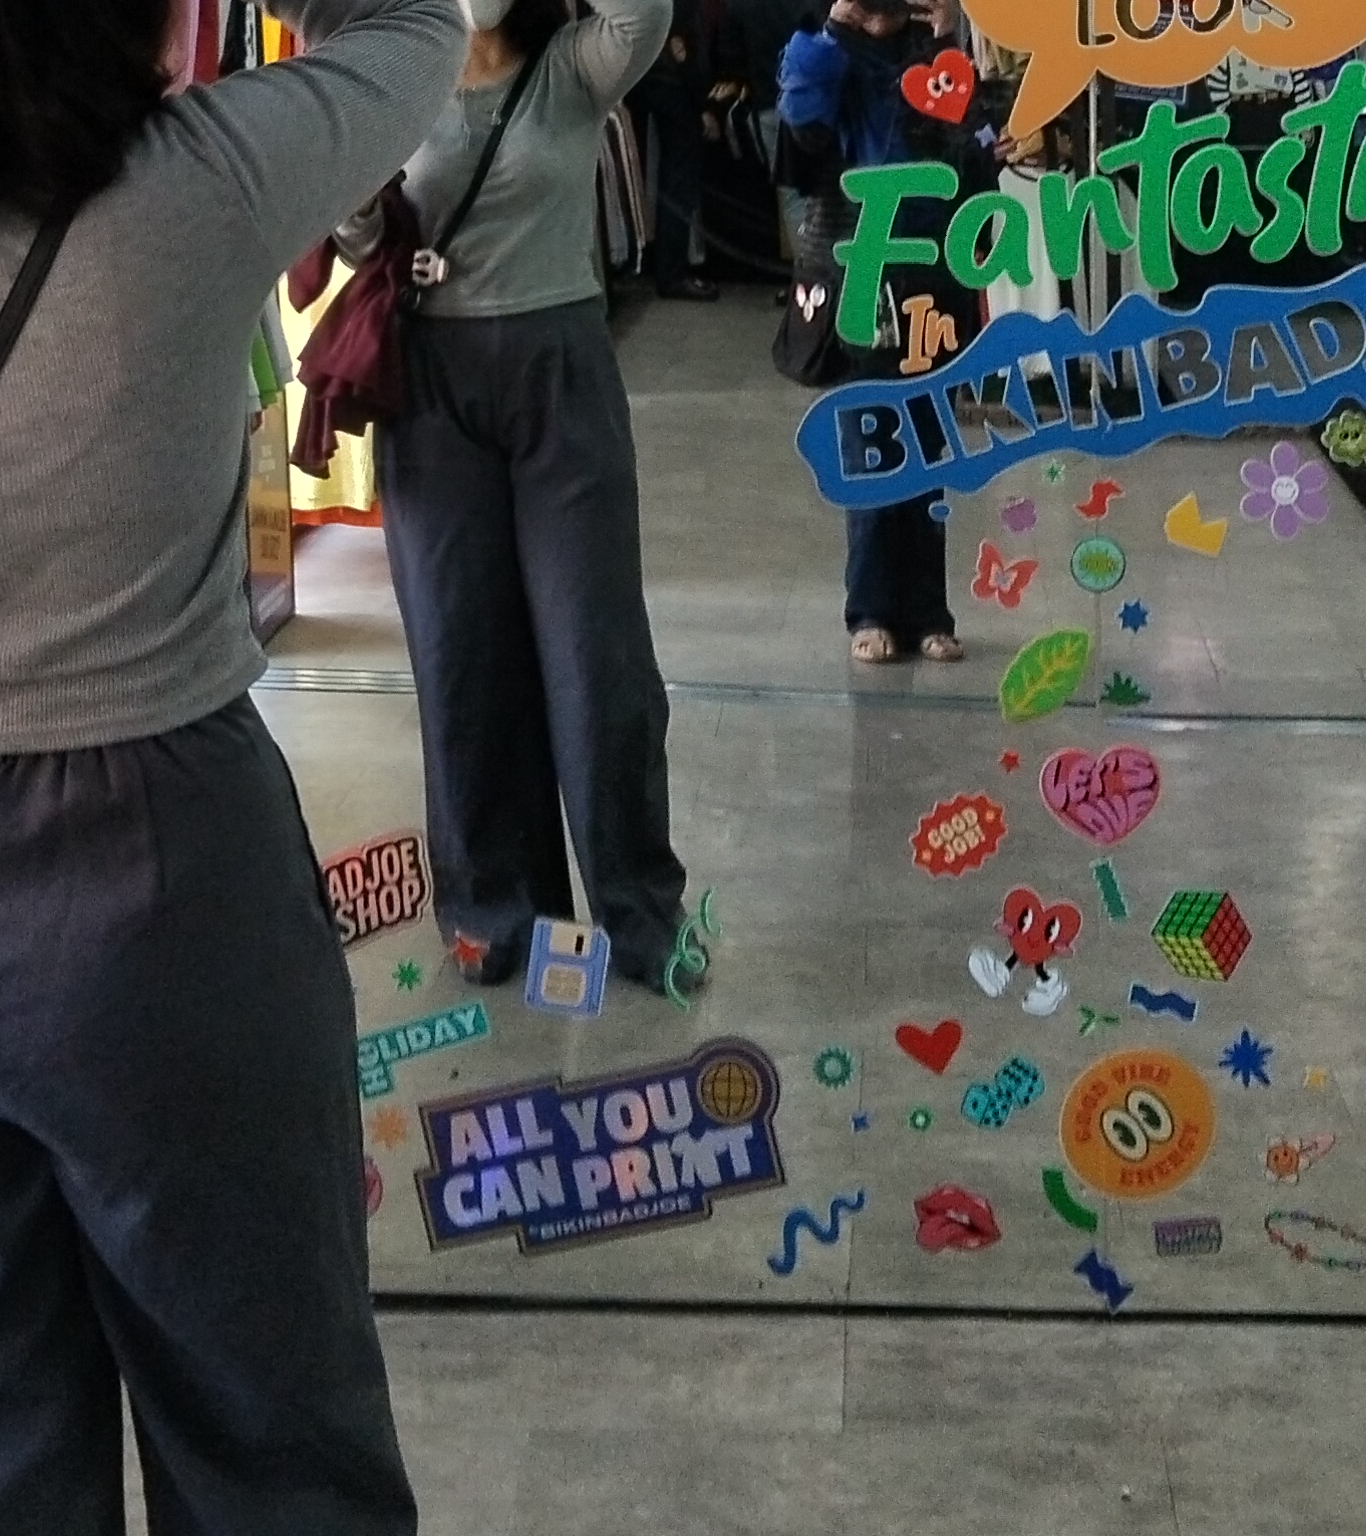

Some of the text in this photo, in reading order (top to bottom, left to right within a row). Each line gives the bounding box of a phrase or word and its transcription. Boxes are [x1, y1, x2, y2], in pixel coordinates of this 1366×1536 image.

[898, 294, 959, 375] In
[928, 806, 979, 849] GOOD
[943, 823, 987, 864] JOB!
[336, 880, 422, 944] SHOP
[449, 1076, 693, 1168] ALL YOU
[1074, 1079, 1109, 1145] GOOD
[442, 1124, 754, 1229] CAN PRINT
